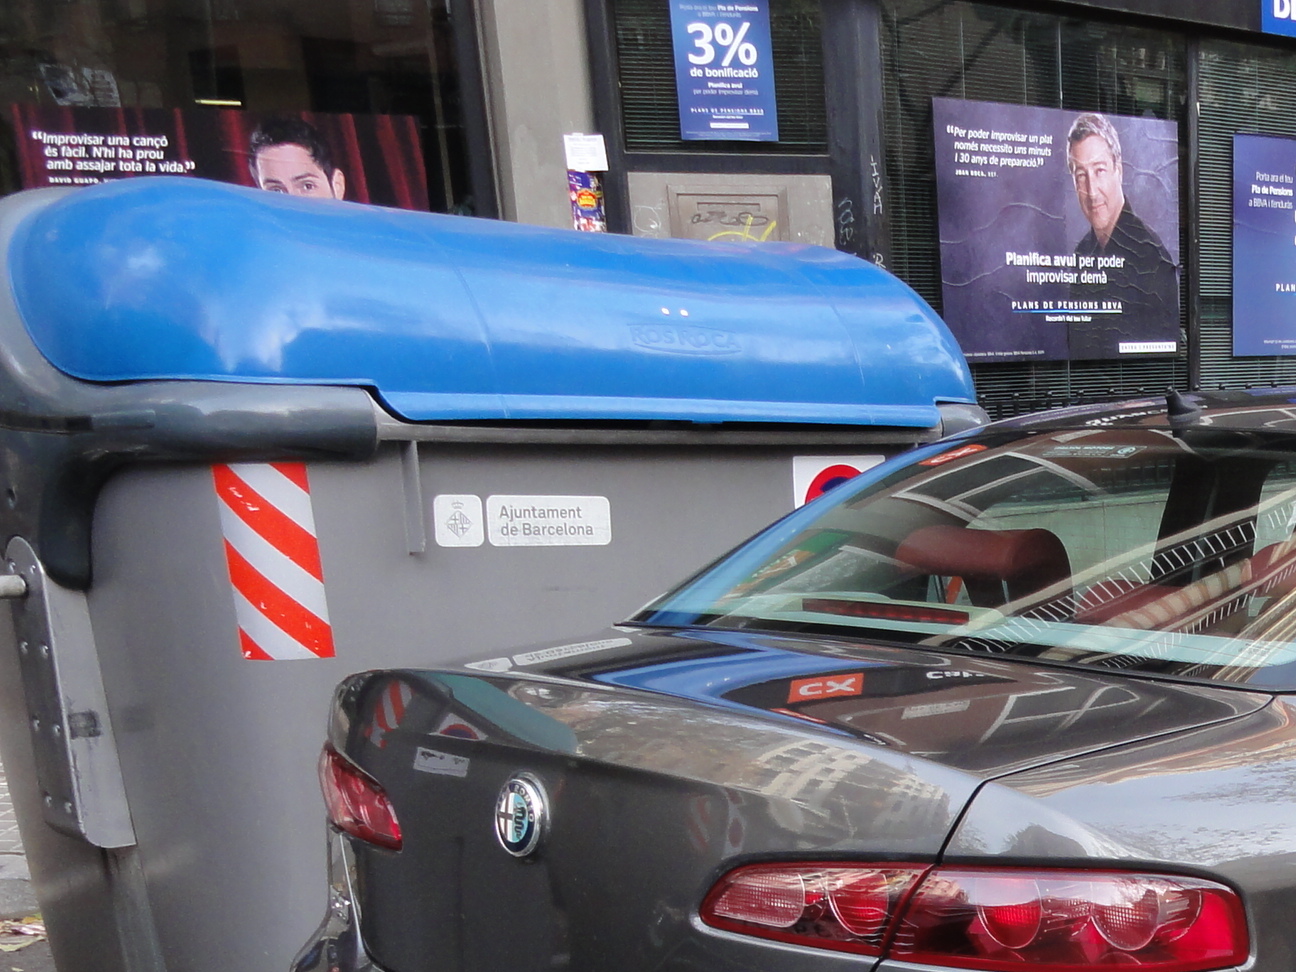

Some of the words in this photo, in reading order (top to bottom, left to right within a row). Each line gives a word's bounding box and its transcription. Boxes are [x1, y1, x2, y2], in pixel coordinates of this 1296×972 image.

[687, 22, 758, 67] 3%
[690, 67, 703, 77] de
[705, 67, 758, 78] bonificació
[108, 135, 130, 146] una
[133, 135, 168, 148] cançó
[967, 129, 989, 140] poder
[991, 130, 1027, 142] improvisar
[1029, 135, 1038, 143] un
[1039, 134, 1053, 145] plat
[45, 146, 58, 157] és
[61, 146, 89, 158] fàcil.
[118, 148, 133, 159] ha
[136, 150, 164, 160] prou
[954, 141, 979, 151] només
[980, 143, 1012, 154] necessito
[1014, 146, 1027, 155] uns
[1028, 146, 1051, 156] minuts
[47, 159, 73, 170] amb
[76, 161, 116, 173] assajar
[119, 161, 142, 172] tota
[145, 161, 156, 172] la
[959, 153, 970, 163] 30
[971, 155, 988, 166] anys
[989, 155, 999, 165] de
[1251, 185, 1261, 194] Pla
[1262, 185, 1269, 195] de
[1270, 186, 1293, 197] Pensions
[1006, 252, 1052, 266] Planifica
[1054, 254, 1077, 268] avui
[1079, 256, 1095, 270] per
[1097, 255, 1125, 271] poder
[1026, 269, 1077, 285] improvisar
[1081, 270, 1107, 284] demà
[1012, 301, 1039, 310] PLANS
[1057, 301, 1098, 310] PENSIONS
[499, 505, 582, 522] Ajuntament
[501, 523, 521, 536] de
[522, 523, 594, 536] Barcelona
